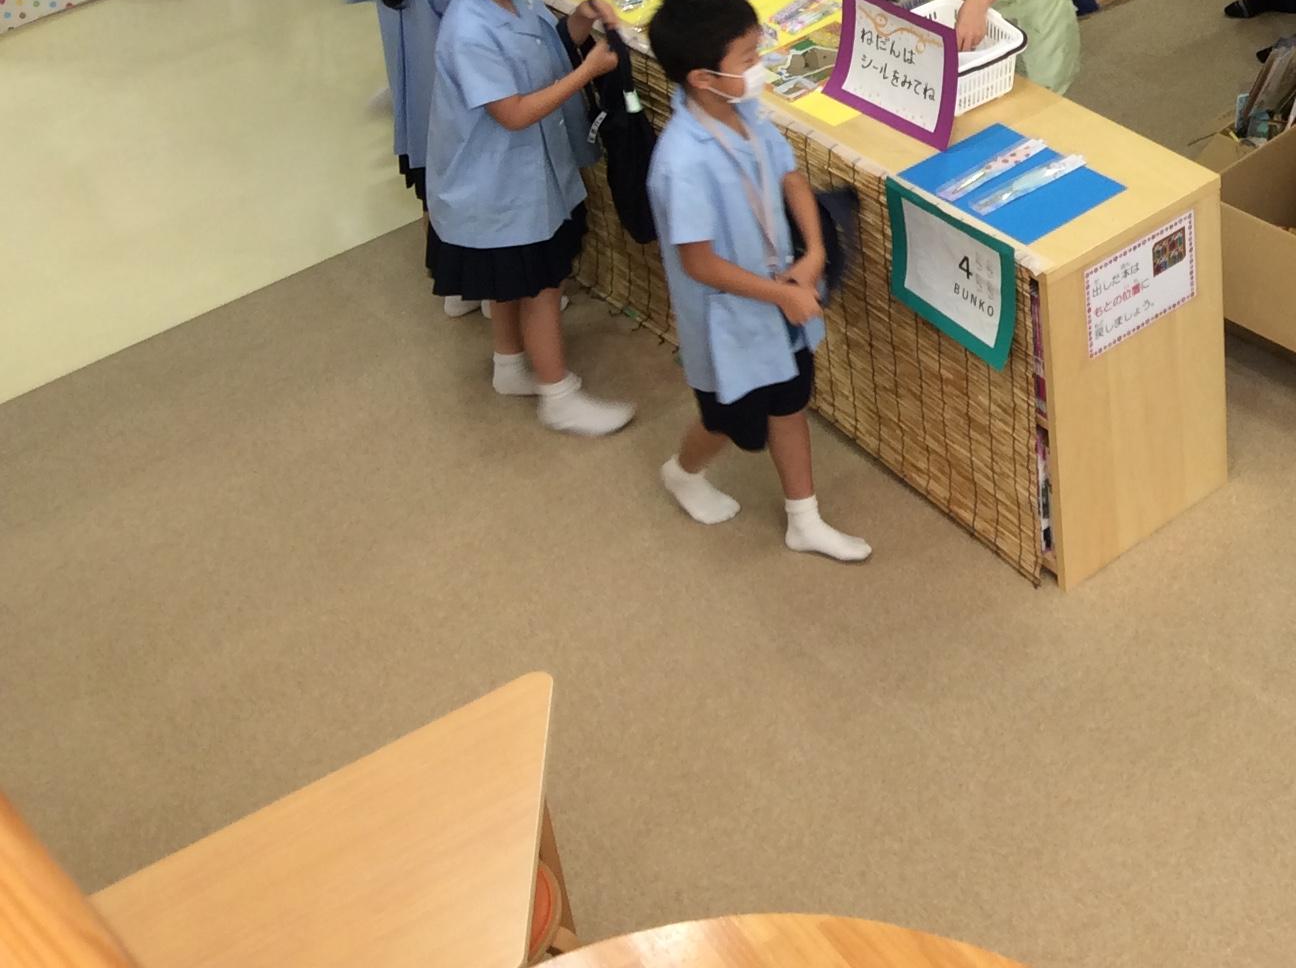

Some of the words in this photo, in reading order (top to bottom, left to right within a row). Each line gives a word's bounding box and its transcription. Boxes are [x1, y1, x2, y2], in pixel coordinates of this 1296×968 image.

[860, 27, 916, 65] ねだんは
[860, 53, 936, 102] シールをみてね
[958, 255, 973, 280] 4
[953, 282, 995, 318] BUNKO
